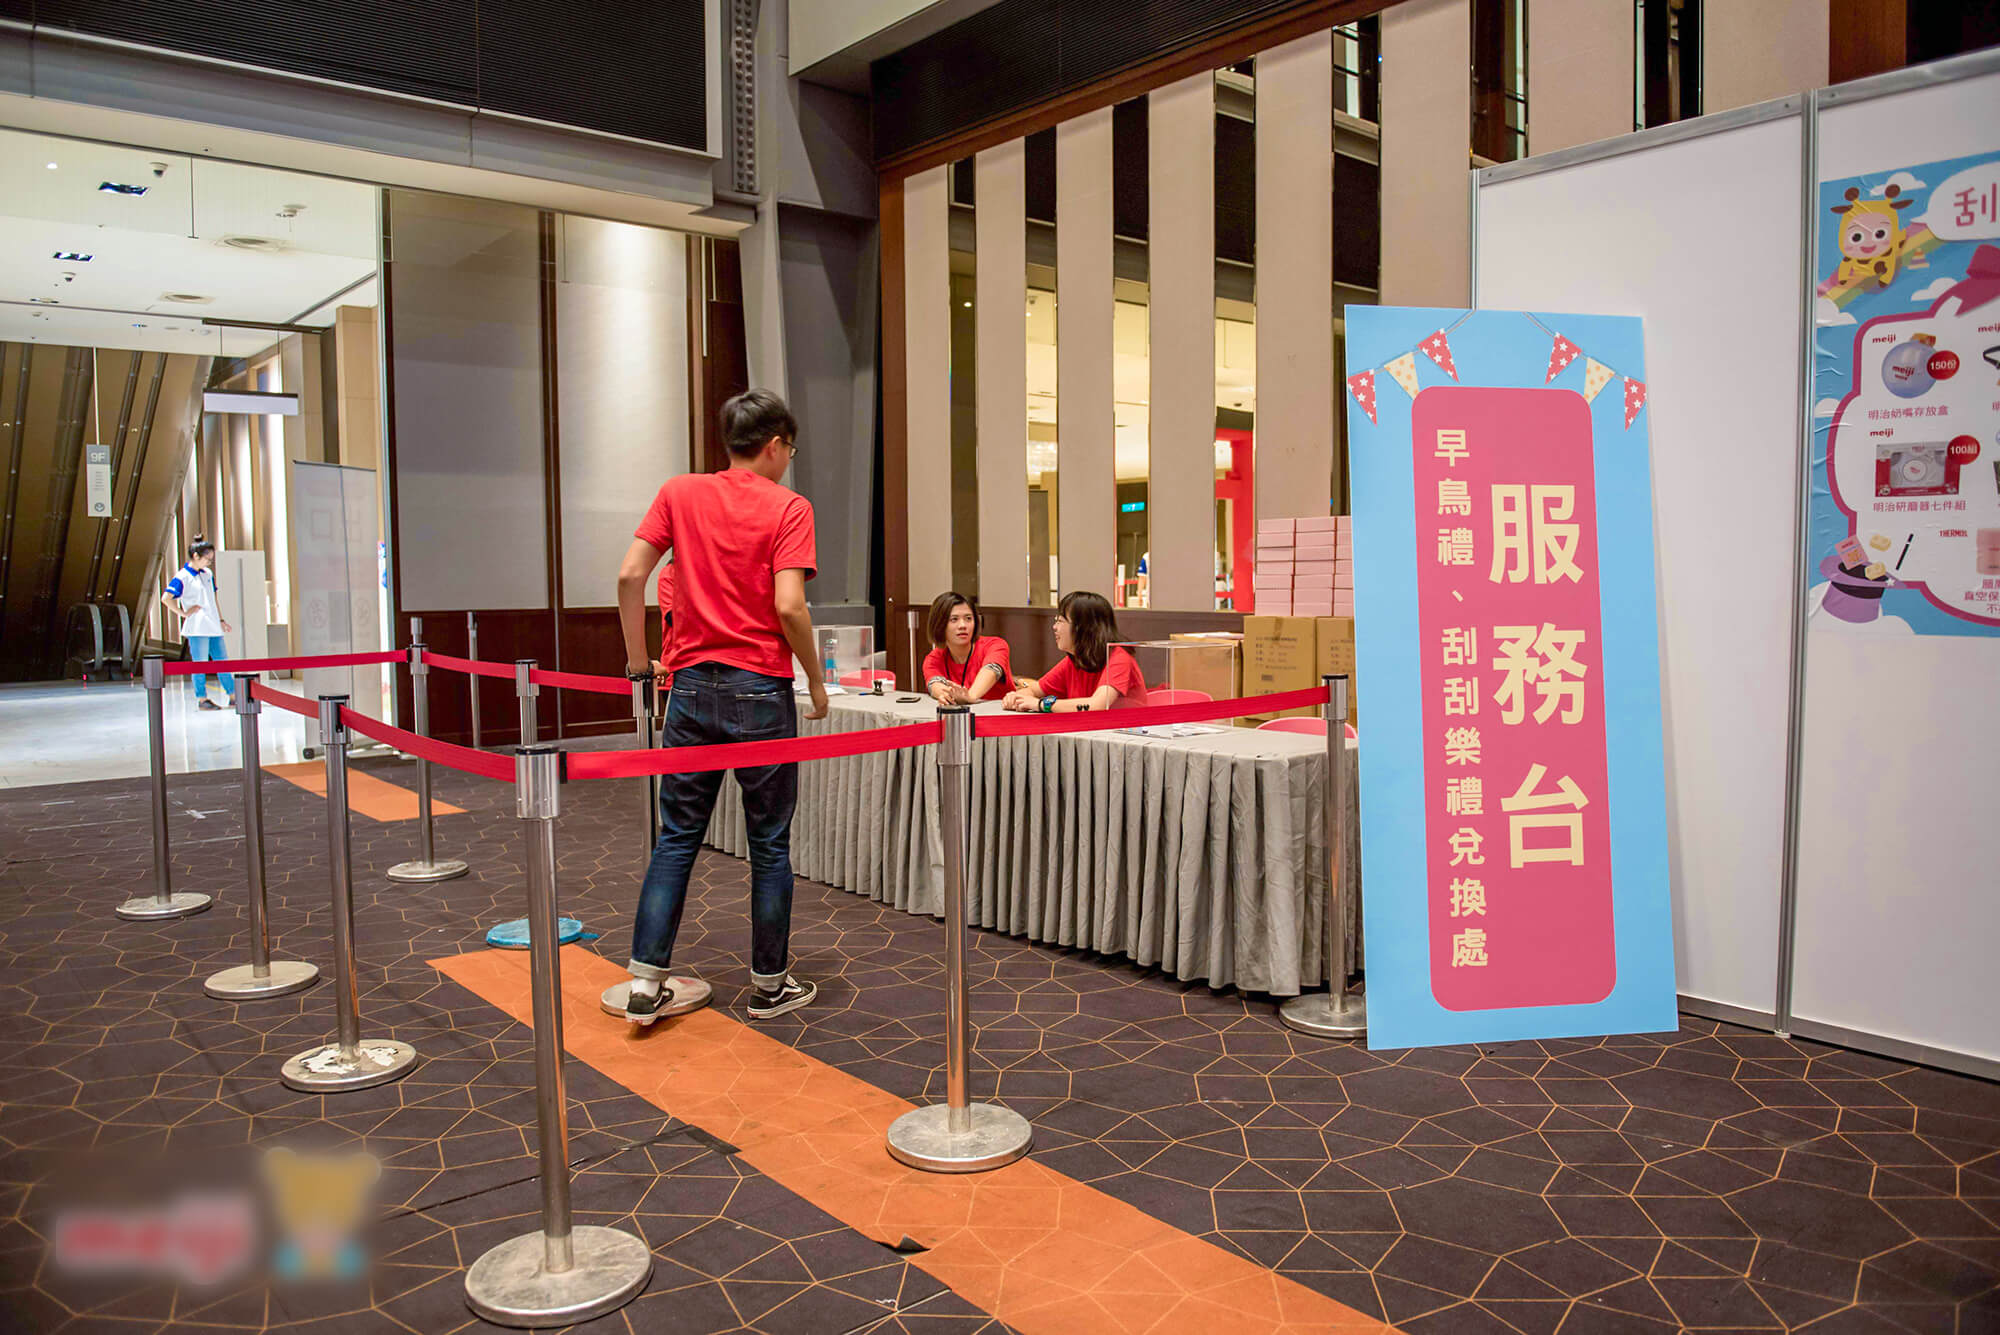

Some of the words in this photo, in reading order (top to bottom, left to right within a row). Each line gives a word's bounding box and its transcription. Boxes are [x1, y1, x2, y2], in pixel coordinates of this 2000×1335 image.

[1953, 183, 1998, 227] 刮
[1872, 333, 1897, 345] meiji
[1869, 427, 1894, 438] meiji
[90, 452, 106, 463] 9F
[1488, 483, 1590, 869] 服務台
